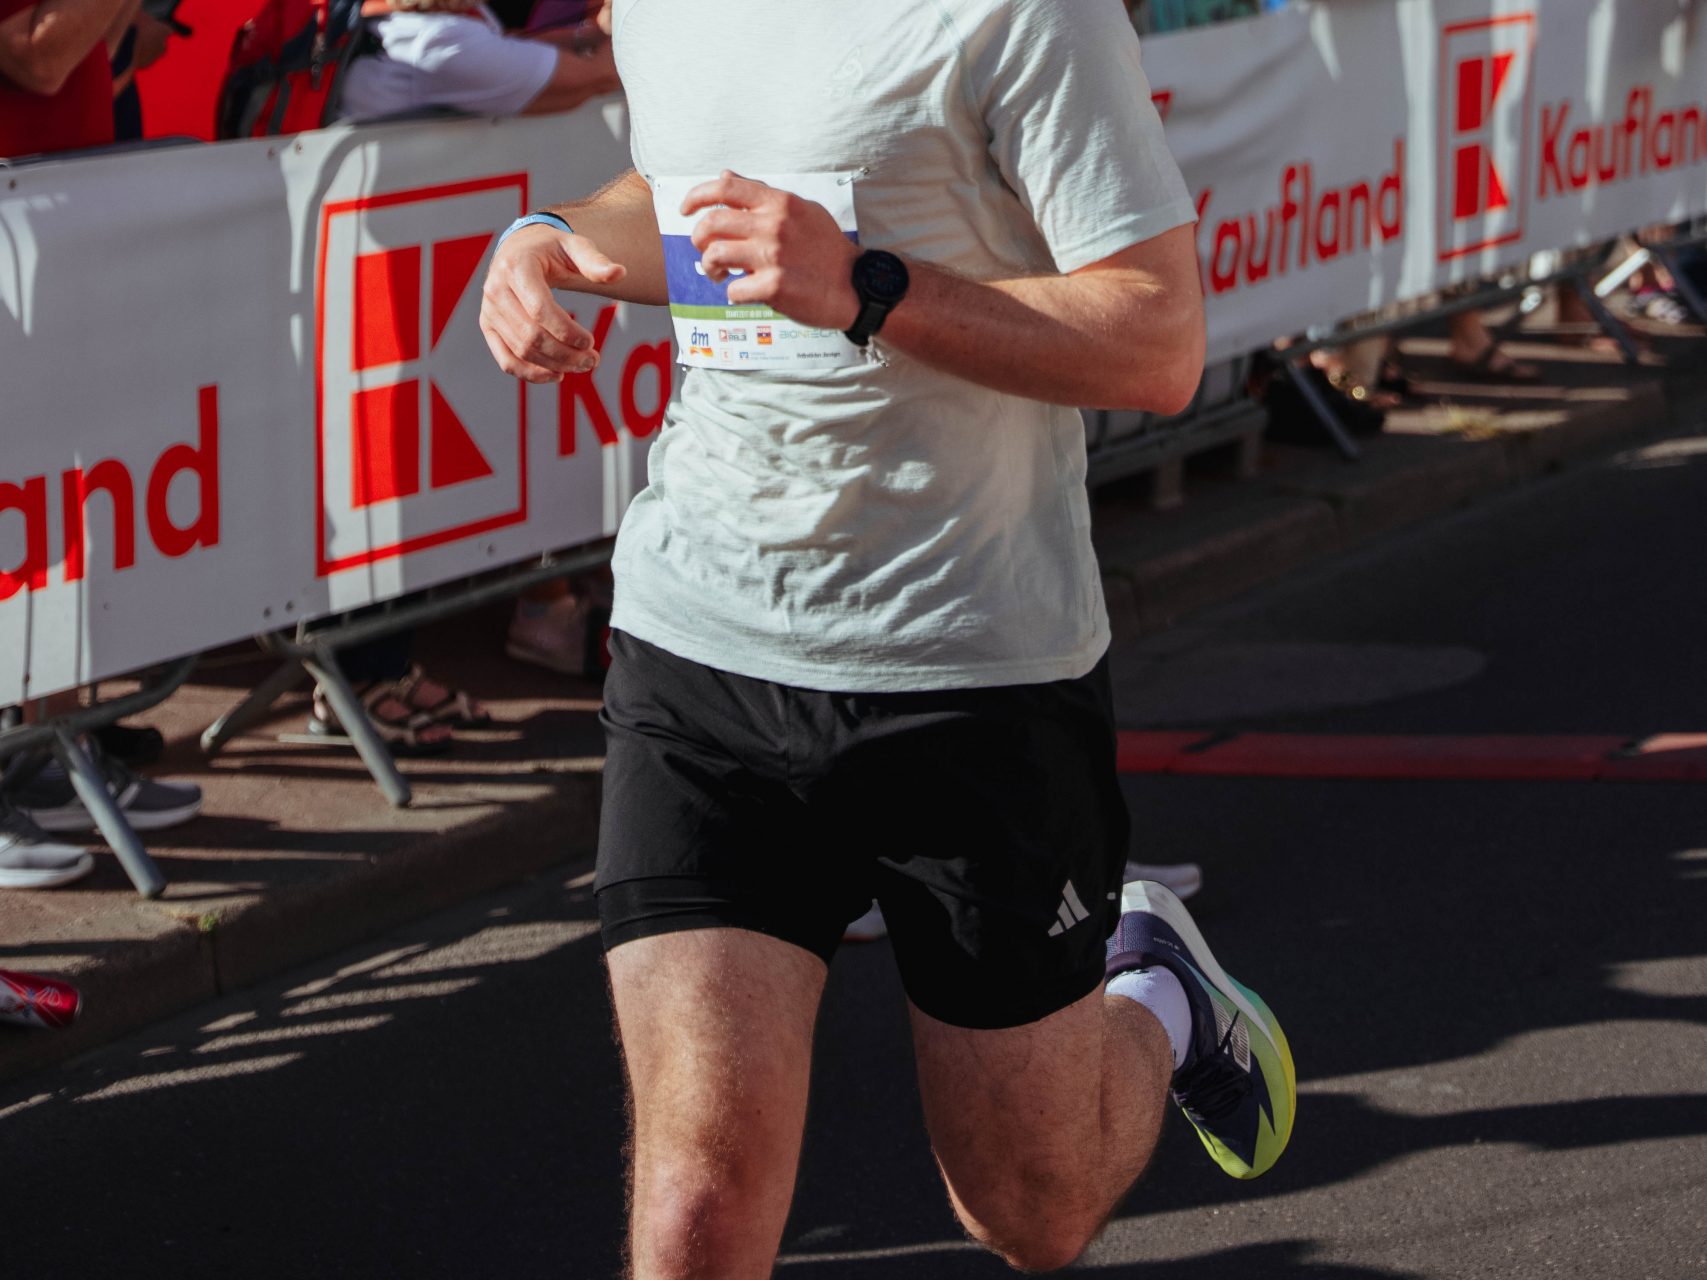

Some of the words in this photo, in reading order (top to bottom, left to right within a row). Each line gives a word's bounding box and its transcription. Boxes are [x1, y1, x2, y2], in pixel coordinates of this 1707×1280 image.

[1538, 83, 1707, 200] Kauflan
[558, 302, 672, 456] Ka
[691, 326, 709, 346] dm
[0, 384, 220, 601] and
